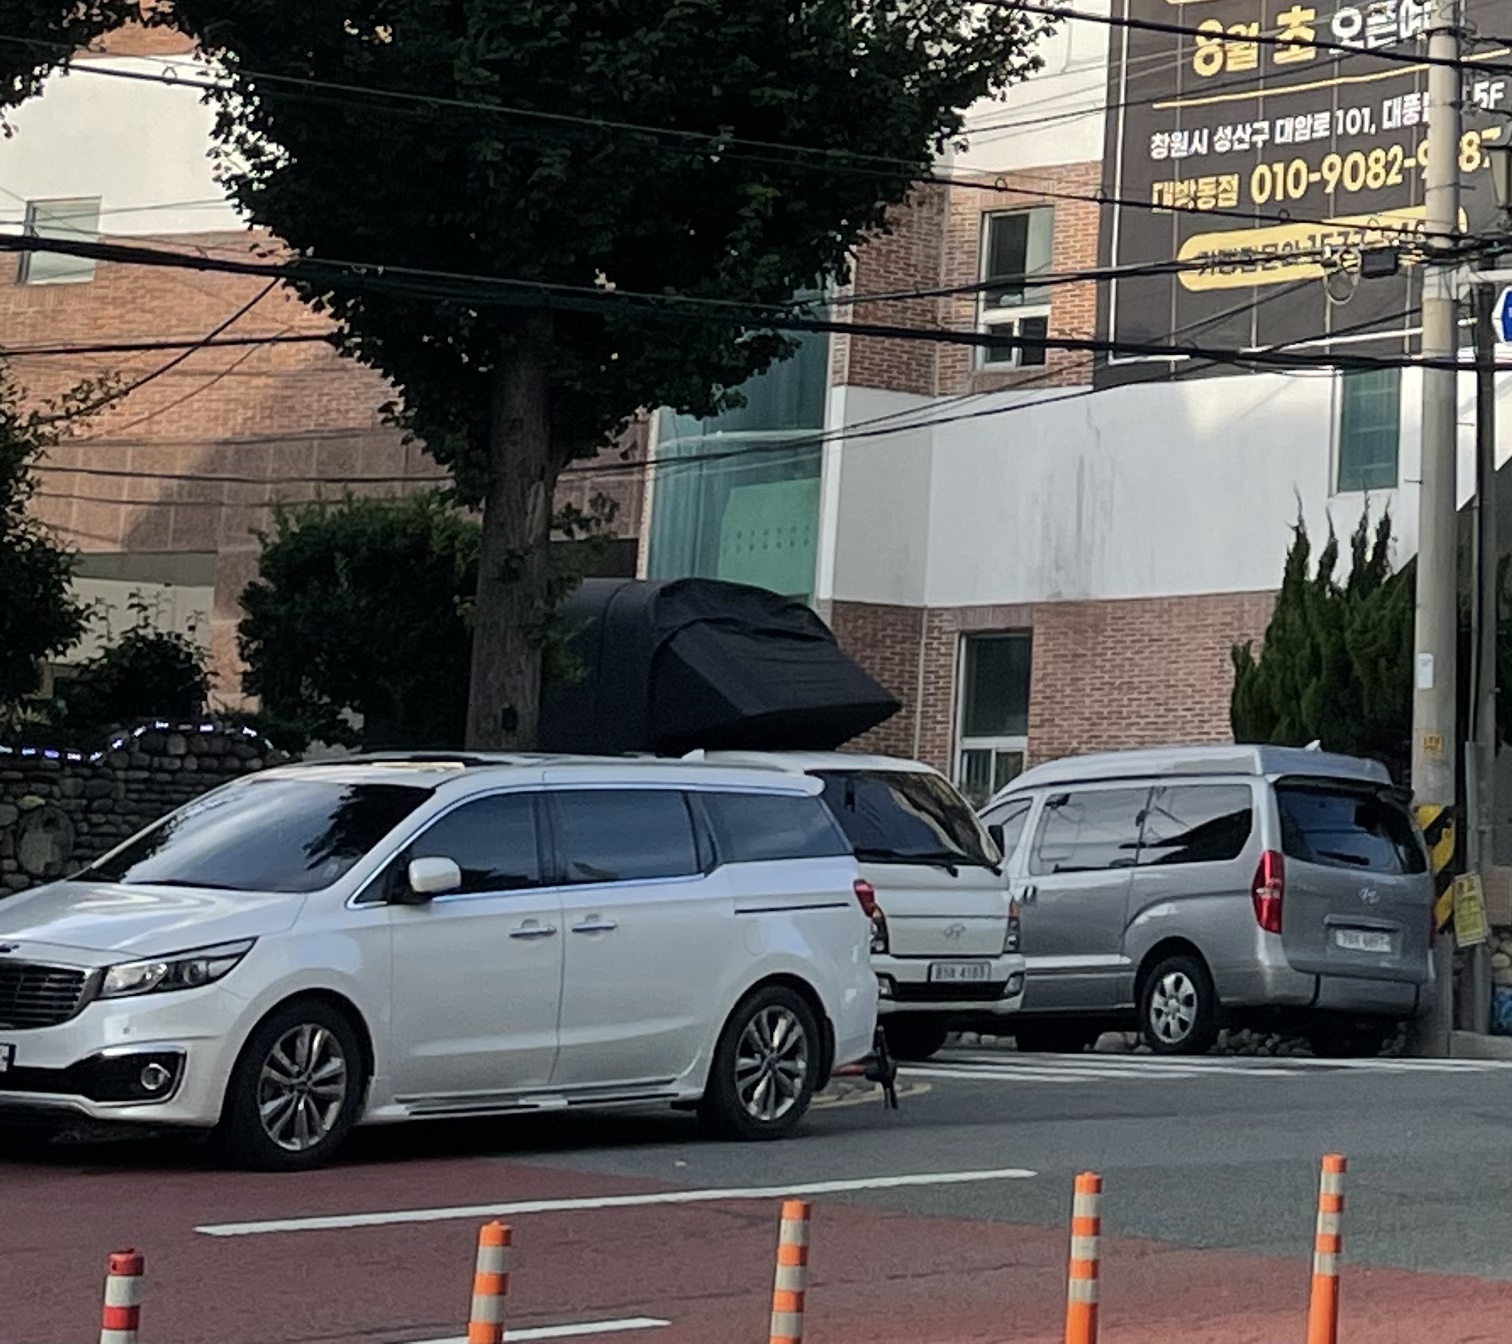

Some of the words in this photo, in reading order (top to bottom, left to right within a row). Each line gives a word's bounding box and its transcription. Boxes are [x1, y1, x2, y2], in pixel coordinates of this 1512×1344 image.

[1193, 19, 1260, 77] 8월
[1275, 5, 1317, 67] 초
[1150, 128, 1208, 160] 창원시
[1213, 120, 1270, 153] 성산구
[1274, 111, 1331, 144] 대암로
[1336, 107, 1376, 135] 101,
[1473, 81, 1506, 109] 5F
[1152, 173, 1239, 213] 대방동점
